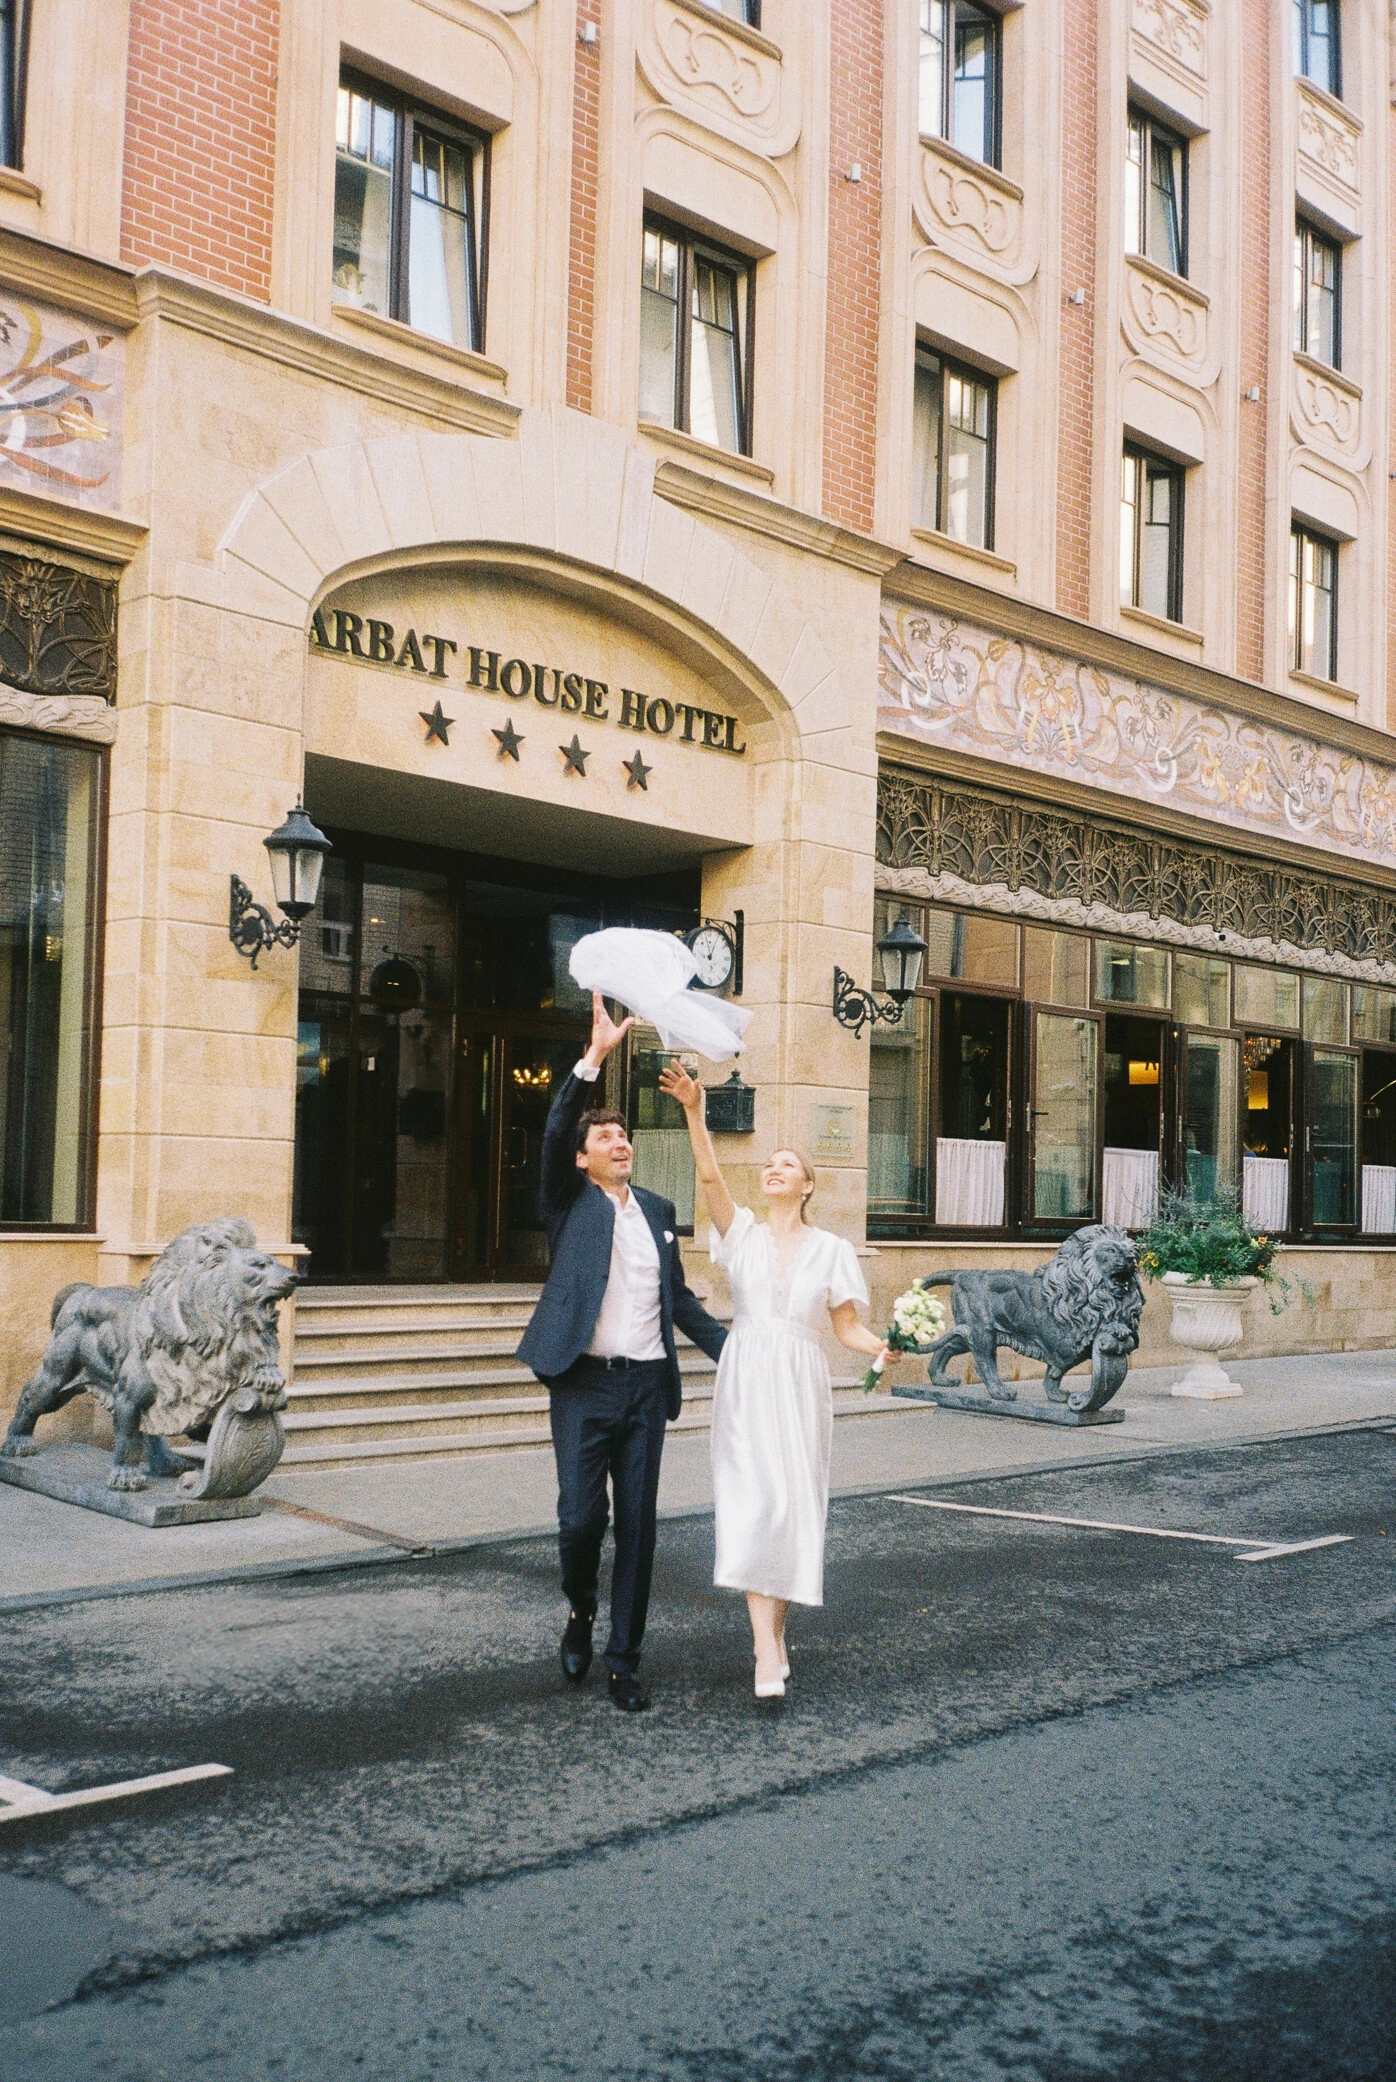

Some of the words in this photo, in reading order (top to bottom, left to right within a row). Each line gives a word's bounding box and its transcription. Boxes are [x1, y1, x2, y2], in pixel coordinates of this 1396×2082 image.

[310, 607, 457, 678] ARBAT
[466, 645, 609, 719] HOUSE
[617, 688, 746, 754] HOTEL
